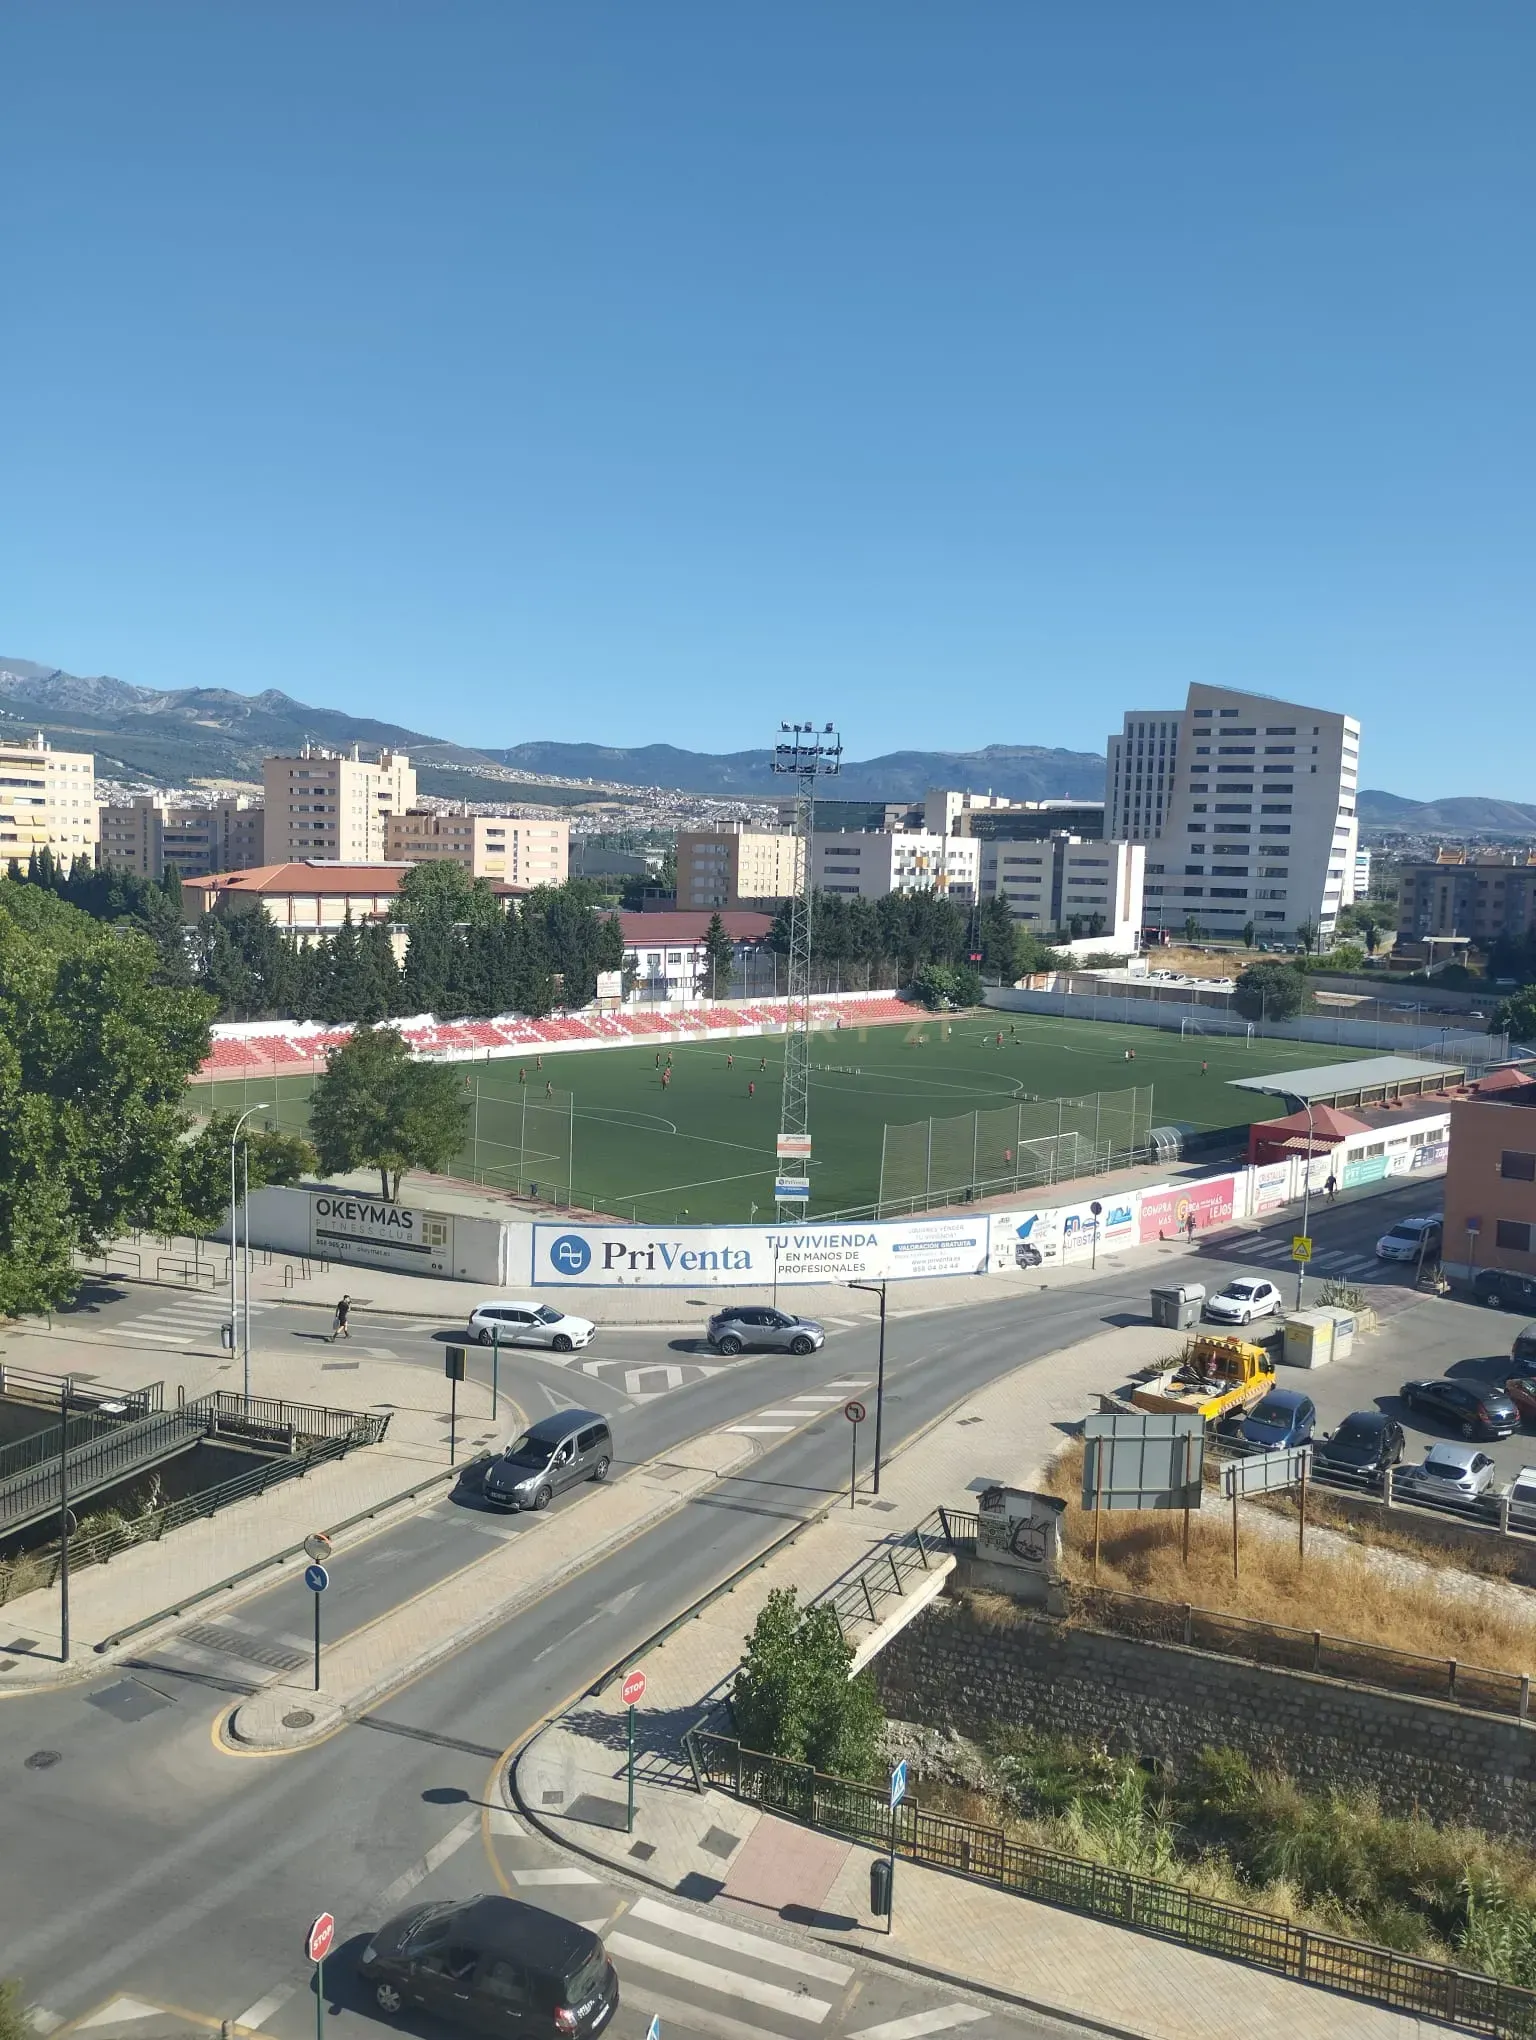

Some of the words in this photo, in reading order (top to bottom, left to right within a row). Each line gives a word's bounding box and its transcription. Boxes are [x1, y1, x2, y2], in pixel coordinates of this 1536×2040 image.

[316, 1199, 413, 1229] OKEYMAS
[1142, 1201, 1172, 1217] COMPRA
[1209, 1203, 1232, 1219] LEJOS
[316, 1219, 374, 1235] FITNESS
[379, 1229, 413, 1241] CLUB
[766, 1235, 788, 1249] TU
[794, 1234, 878, 1249] VIVIENDA
[898, 1242, 939, 1251] VALORACIÓN
[941, 1240, 971, 1249] GRATUITA
[601, 1242, 752, 1271] PriVenta
[786, 1252, 800, 1261] EN
[804, 1251, 842, 1261] MANOS
[845, 1251, 859, 1260] DE
[778, 1263, 866, 1274] PROFESIONALES
[624, 1680, 644, 1696] STOP
[313, 1924, 332, 1951] STOP
